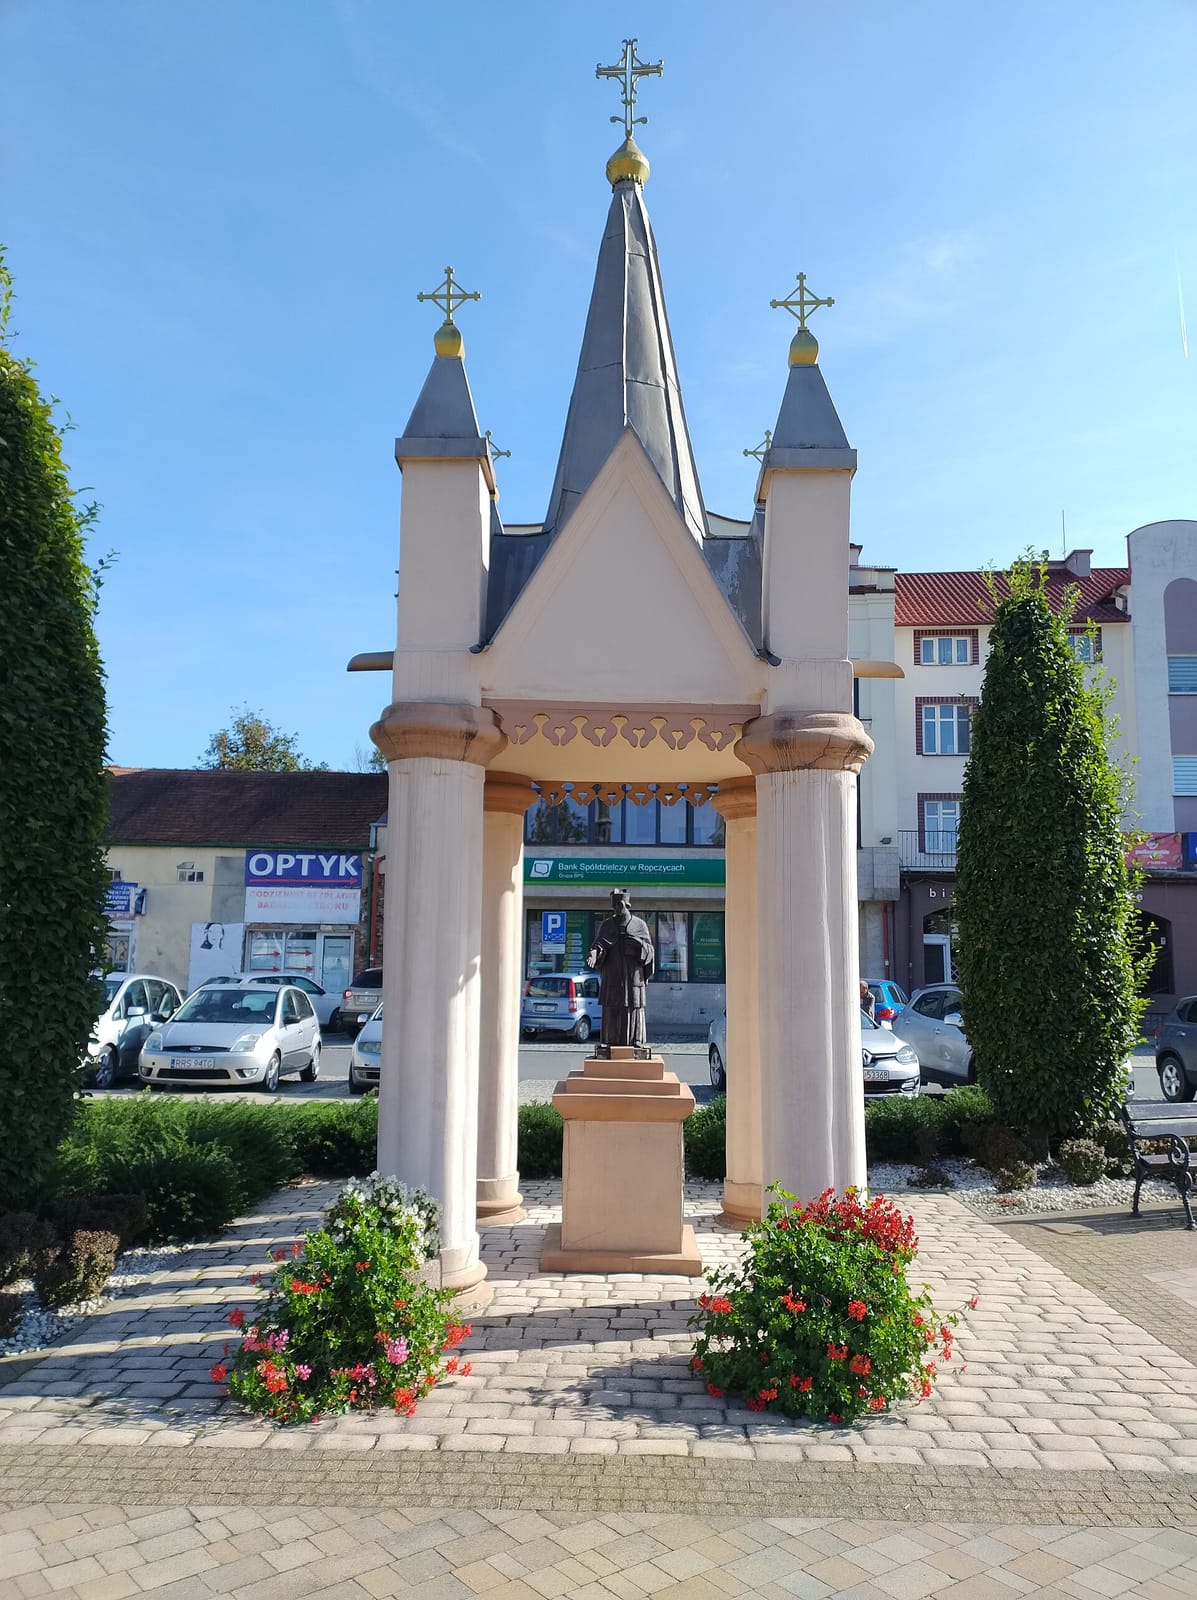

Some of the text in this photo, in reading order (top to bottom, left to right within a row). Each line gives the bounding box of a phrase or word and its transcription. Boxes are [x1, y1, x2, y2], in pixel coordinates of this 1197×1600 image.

[248, 853, 359, 876] OPTYK
[558, 862, 578, 871] Bank
[579, 862, 628, 874] Spółdzielczy
[638, 863, 685, 874] Ropczycach
[547, 914, 561, 934] P
[175, 1059, 192, 1068] RRS
